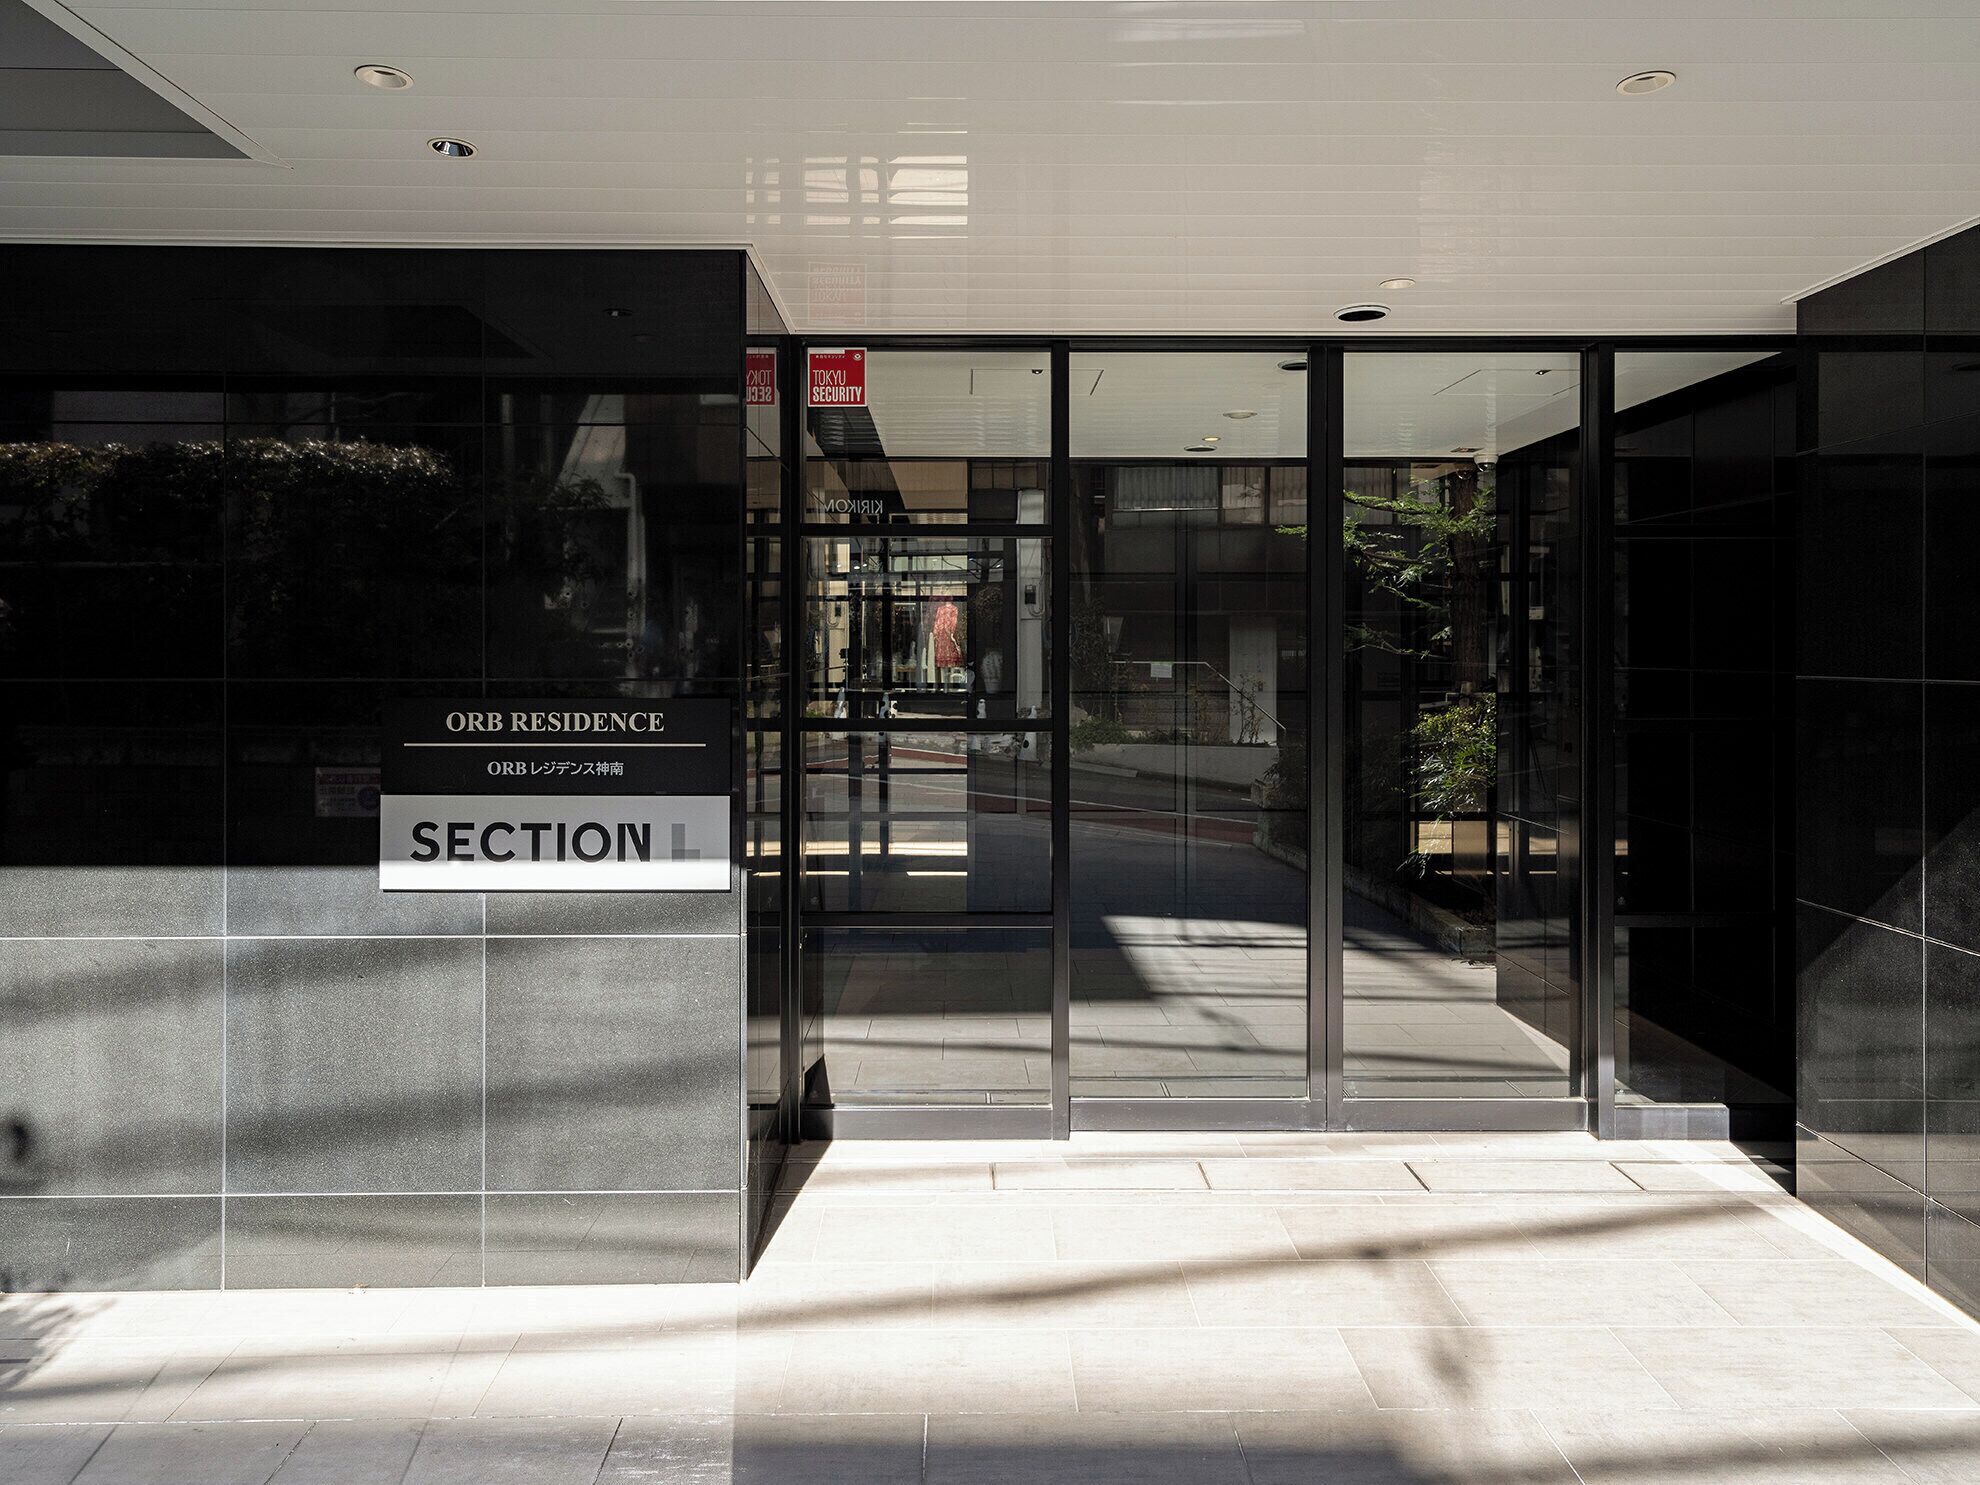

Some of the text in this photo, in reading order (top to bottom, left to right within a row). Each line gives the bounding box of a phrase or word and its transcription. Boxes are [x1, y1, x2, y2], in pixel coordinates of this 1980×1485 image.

[813, 370, 846, 386] TOKYU
[812, 386, 862, 402] SECURITY
[446, 712, 665, 732] ORB RESIDENCE
[487, 761, 624, 776] ORB レジデンス神南
[410, 821, 701, 863] SECTION L
